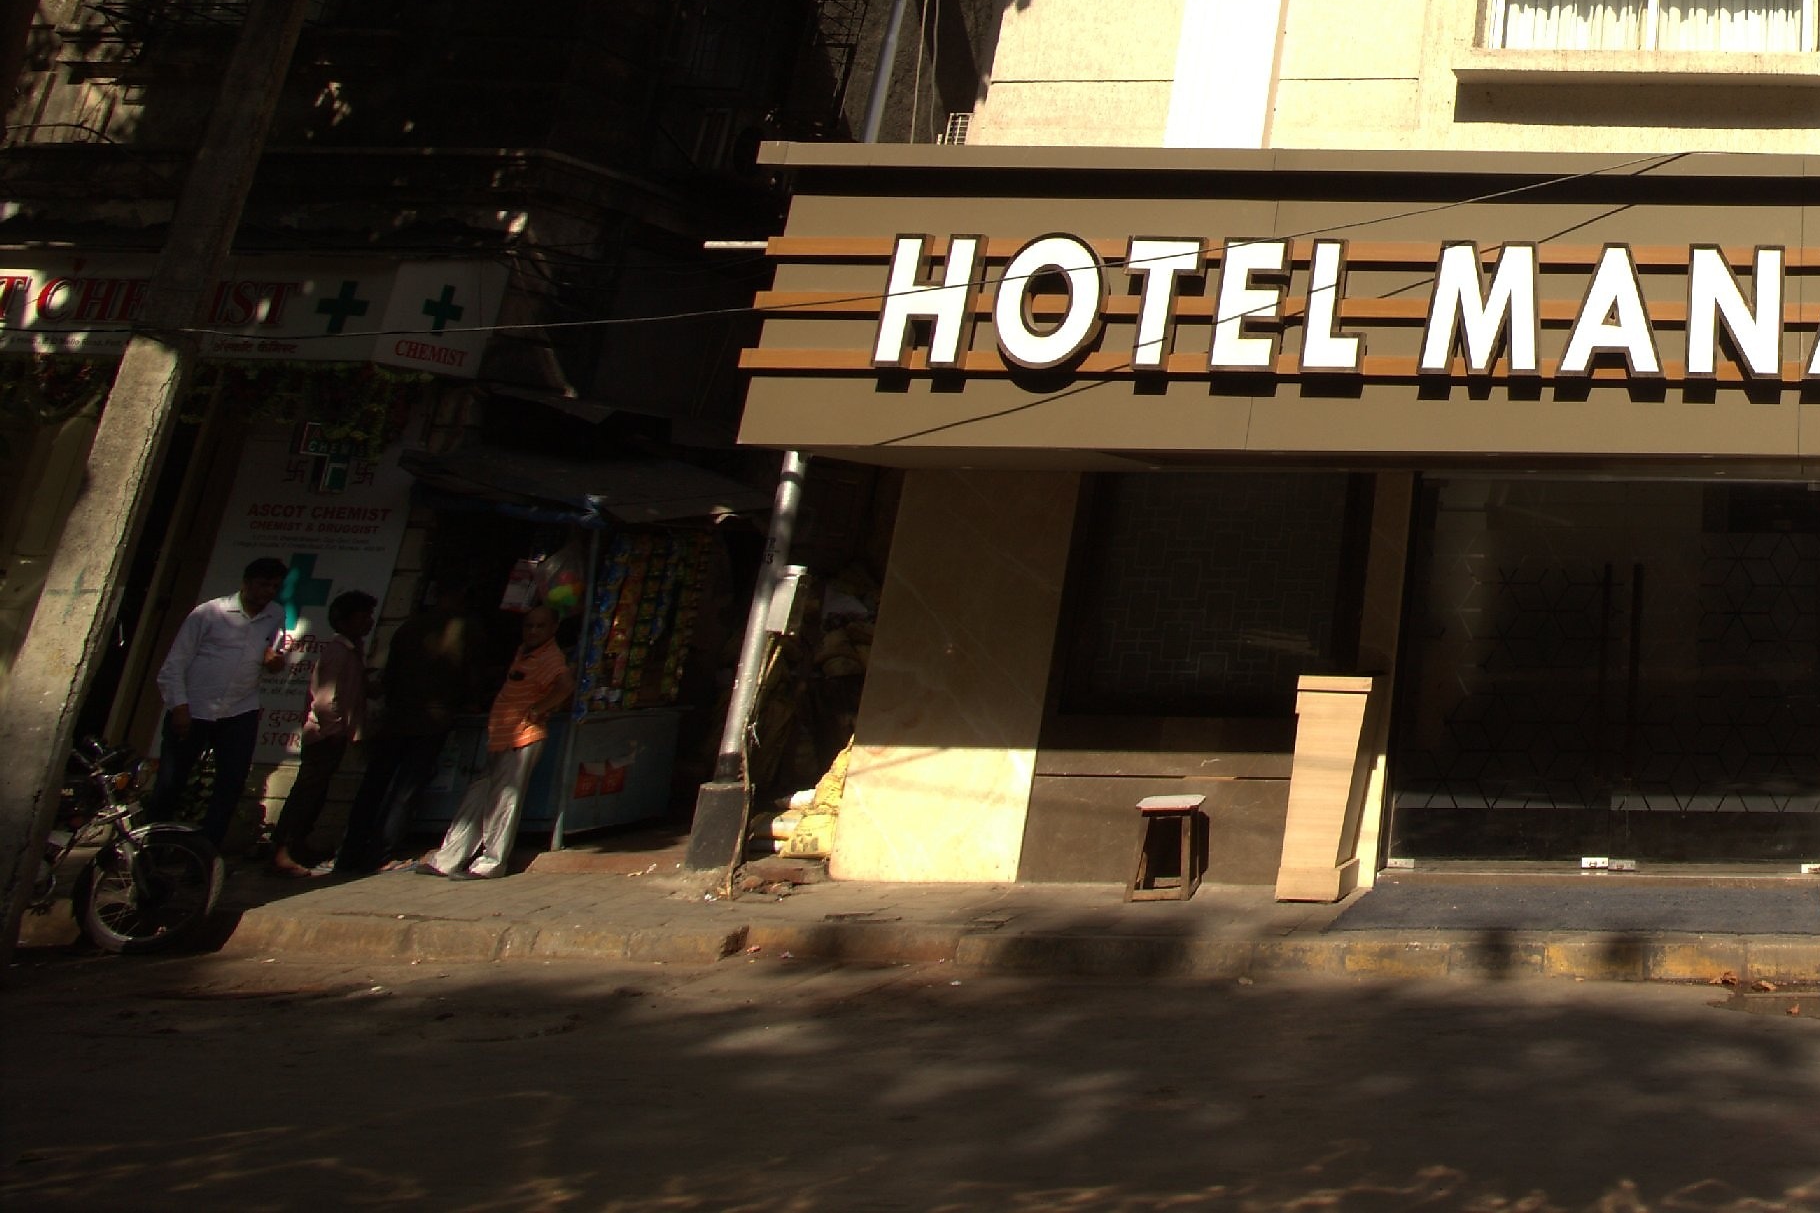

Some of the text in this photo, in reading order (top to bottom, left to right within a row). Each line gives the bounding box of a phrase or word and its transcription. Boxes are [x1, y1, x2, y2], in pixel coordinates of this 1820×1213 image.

[37, 276, 301, 326] CHEIST
[873, 232, 1368, 376] HOTEL
[394, 339, 469, 368] CHEMIST
[247, 503, 393, 522] ASCOT CHEMIST
[249, 520, 380, 535] CHEMIST & DRUGGIST
